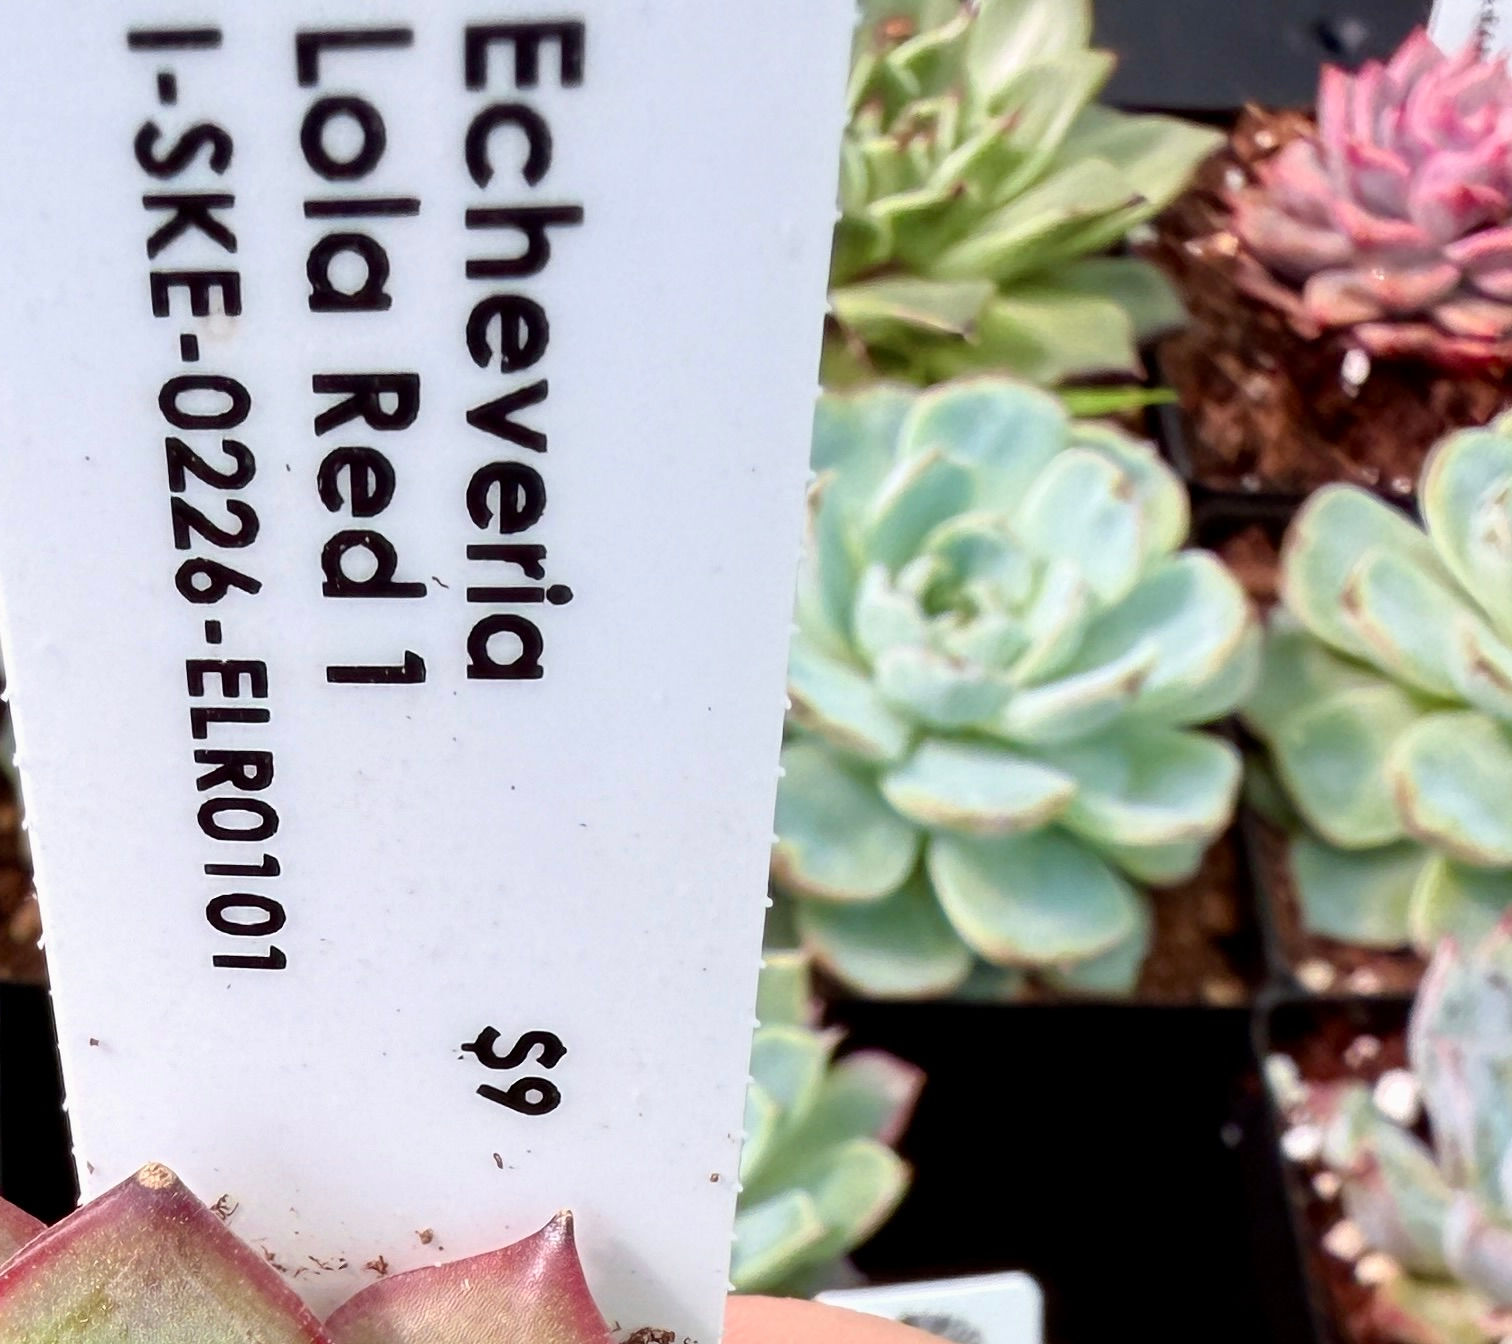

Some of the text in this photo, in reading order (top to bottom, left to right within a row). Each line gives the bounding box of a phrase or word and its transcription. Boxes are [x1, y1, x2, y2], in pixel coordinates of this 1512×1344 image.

[127, 28, 287, 970] I-SKE-0226-ELR0101
[295, 27, 428, 685] Lola Red 1
[464, 20, 586, 680] Echeveria
[460, 1025, 568, 1116] $9
